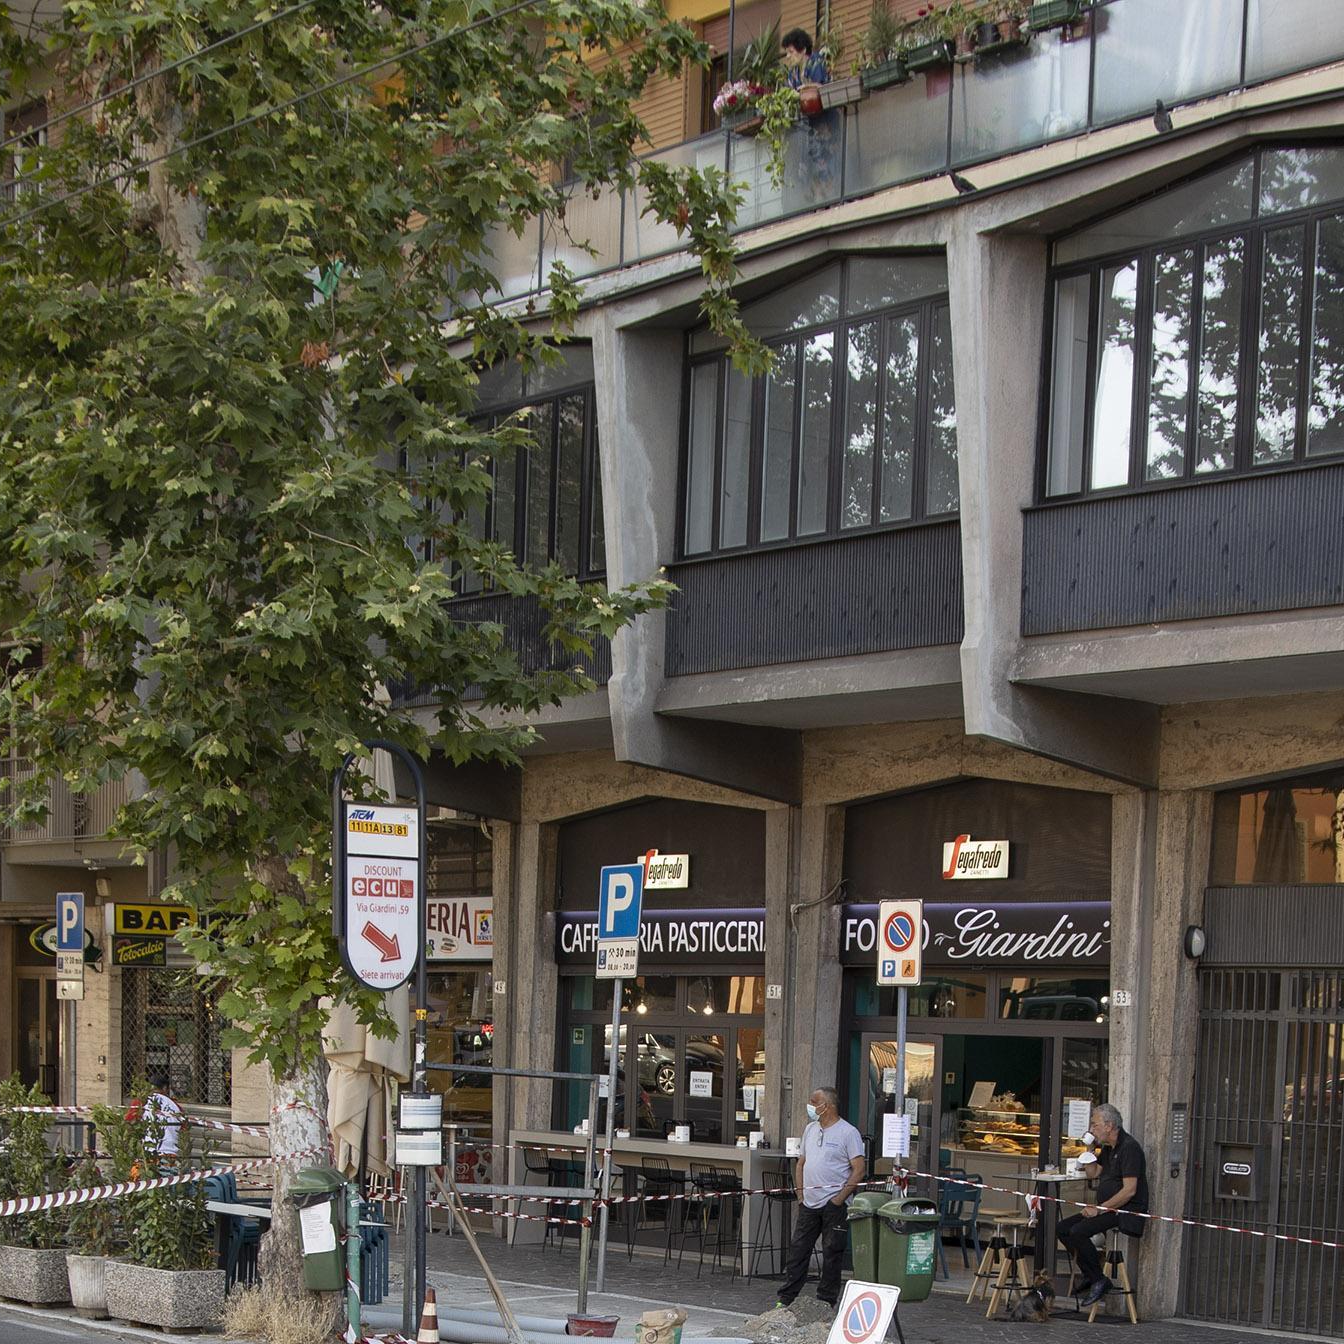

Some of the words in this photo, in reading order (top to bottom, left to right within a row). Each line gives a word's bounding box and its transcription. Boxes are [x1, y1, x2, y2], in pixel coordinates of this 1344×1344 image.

[348, 809, 375, 820] ATCM
[351, 821, 360, 831] 11
[364, 823, 379, 833] 11A
[383, 825, 393, 833] 13
[397, 827, 407, 835] 81
[943, 834, 1001, 879] Segafredo
[364, 865, 402, 877] DISCOUNT
[353, 880, 398, 897] ecu
[356, 903, 368, 912] Via
[369, 903, 397, 914] Giardini
[606, 873, 634, 932] P
[62, 901, 78, 943] P
[427, 903, 472, 945] ERIA
[668, 921, 766, 953] PASTICCERI
[947, 908, 1111, 960] Giardini
[117, 941, 164, 963] Totocalcio
[616, 948, 624, 957] 30
[625, 948, 636, 957] min
[360, 970, 379, 980] Siete
[380, 971, 405, 980] arrivati
[884, 961, 895, 977] P
[769, 986, 779, 997] 51
[1117, 992, 1127, 1004] 53
